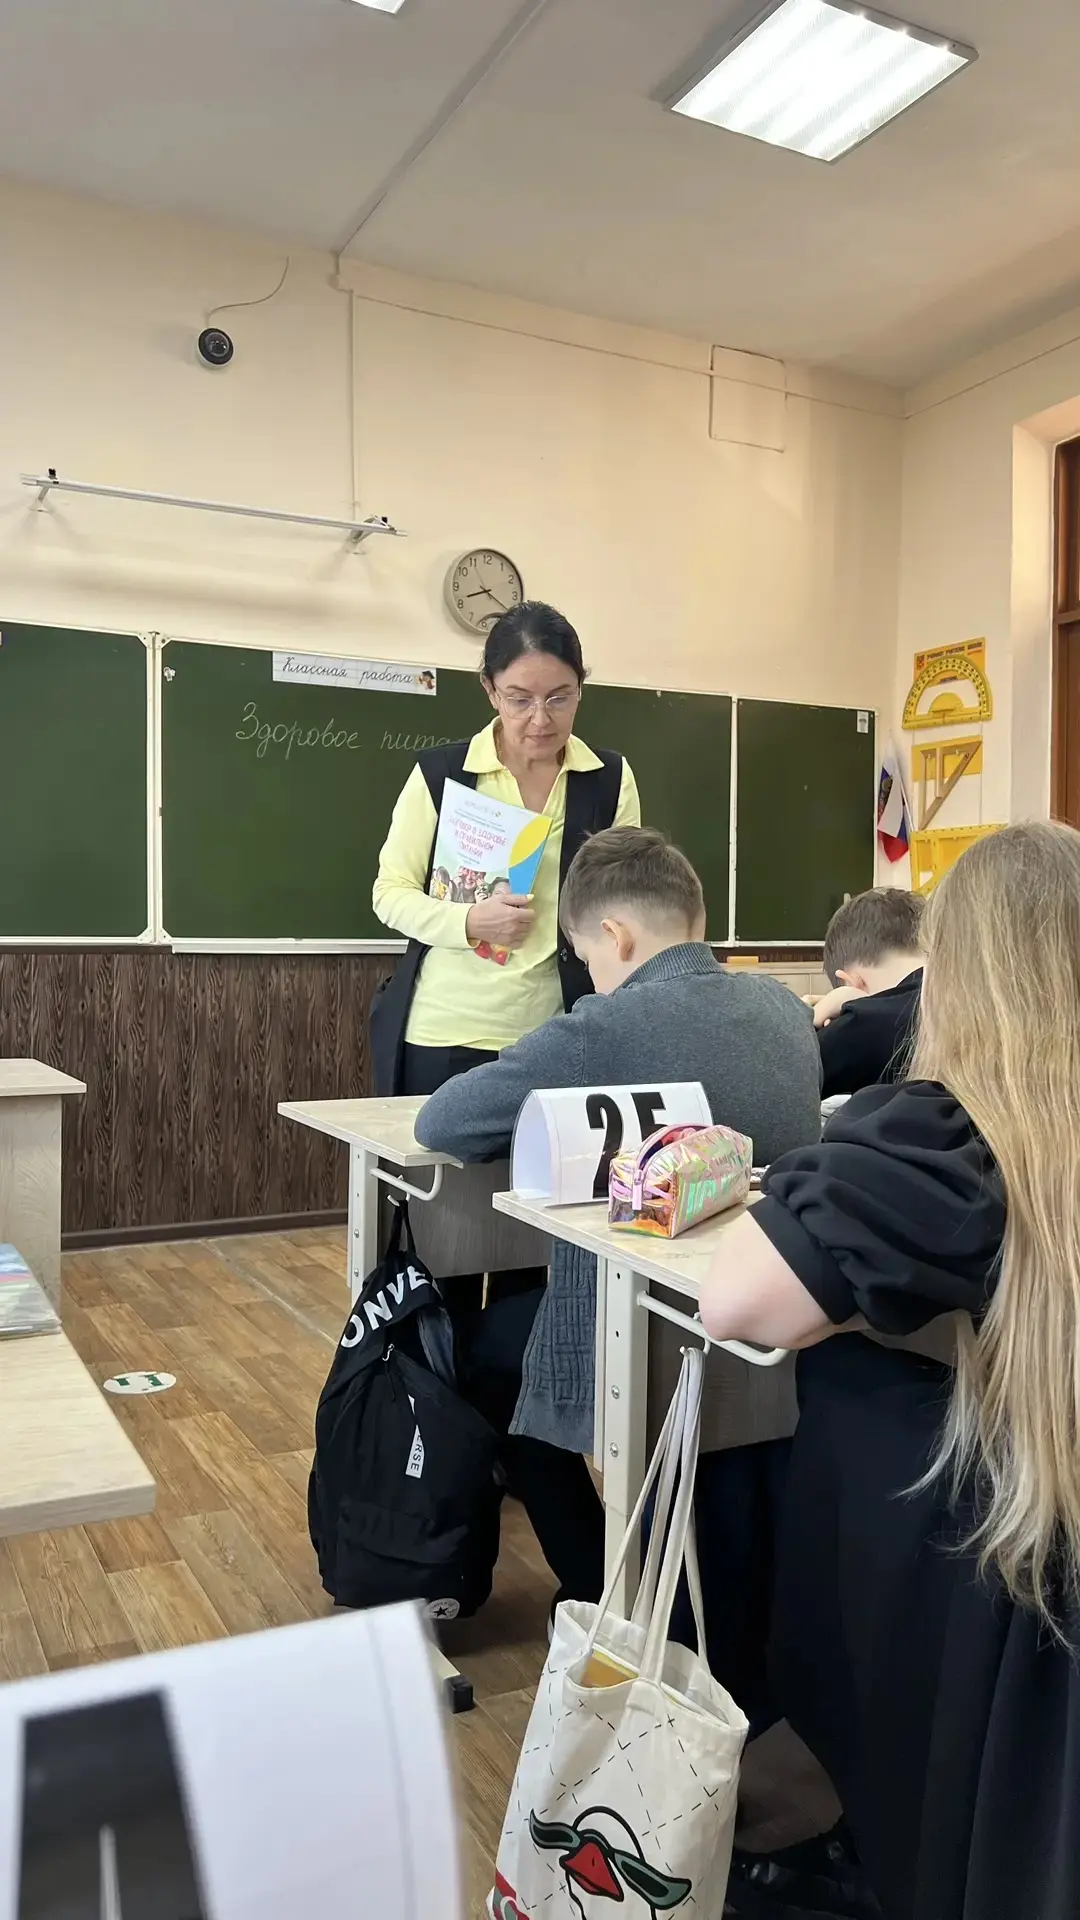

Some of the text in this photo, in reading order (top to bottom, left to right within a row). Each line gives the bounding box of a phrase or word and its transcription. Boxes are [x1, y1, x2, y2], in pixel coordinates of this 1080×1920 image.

[469, 557, 477, 567] 11
[482, 554, 492, 565] 12
[458, 566, 468, 577] 10
[508, 574, 515, 585] 2
[453, 581, 459, 592] 9
[512, 591, 518, 601] 3
[457, 599, 464, 609] 8
[469, 611, 474, 622] 7
[282, 656, 413, 685] Классная работа
[235, 701, 362, 760] Здоровое
[340, 1265, 443, 1348] ONVE
